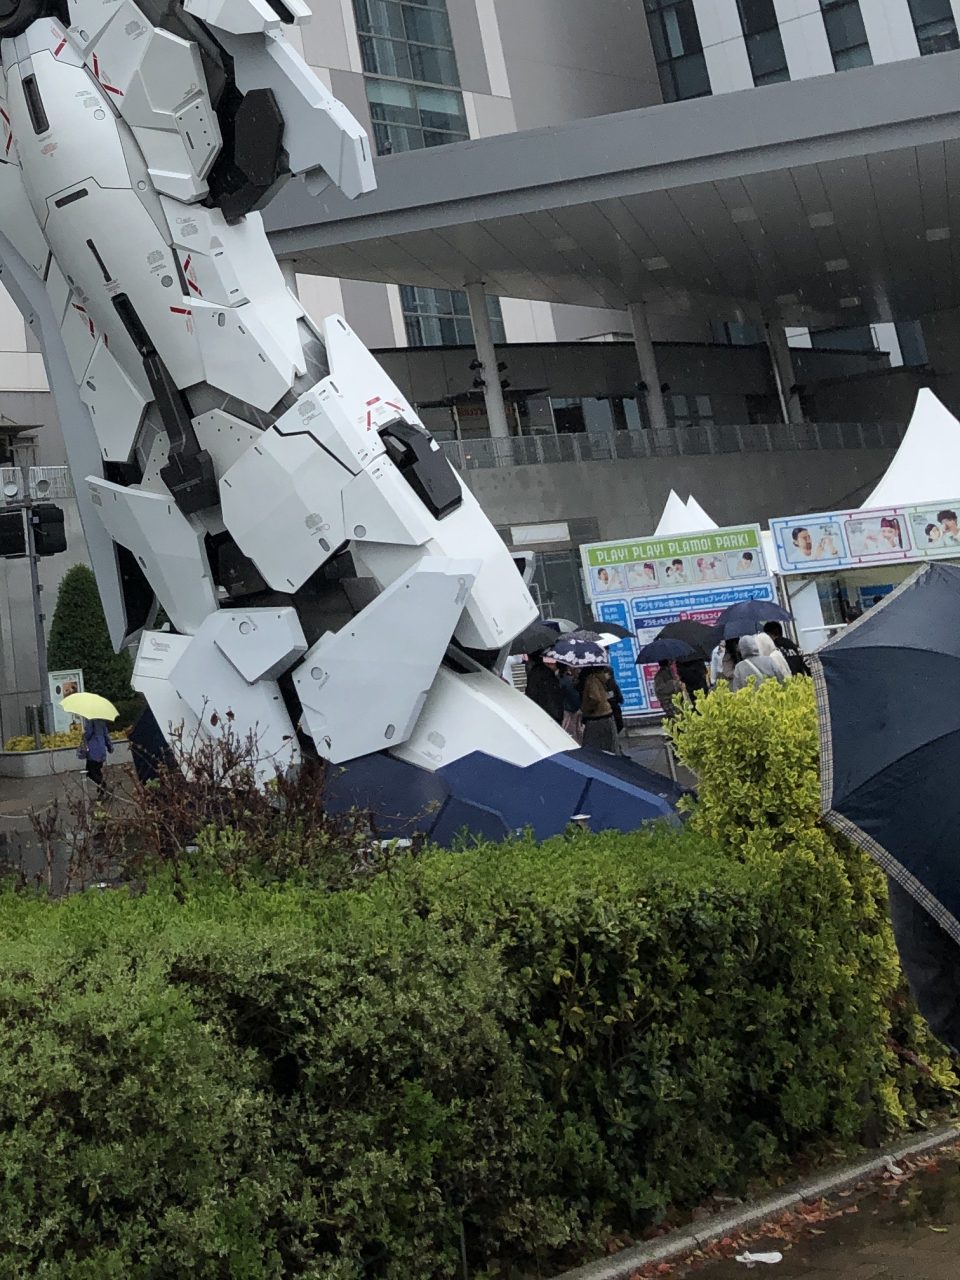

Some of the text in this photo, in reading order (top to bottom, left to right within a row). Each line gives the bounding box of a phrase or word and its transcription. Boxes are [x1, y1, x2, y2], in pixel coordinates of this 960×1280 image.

[596, 533, 749, 563] PLAY! PLAY! PLAMO! PARK!
